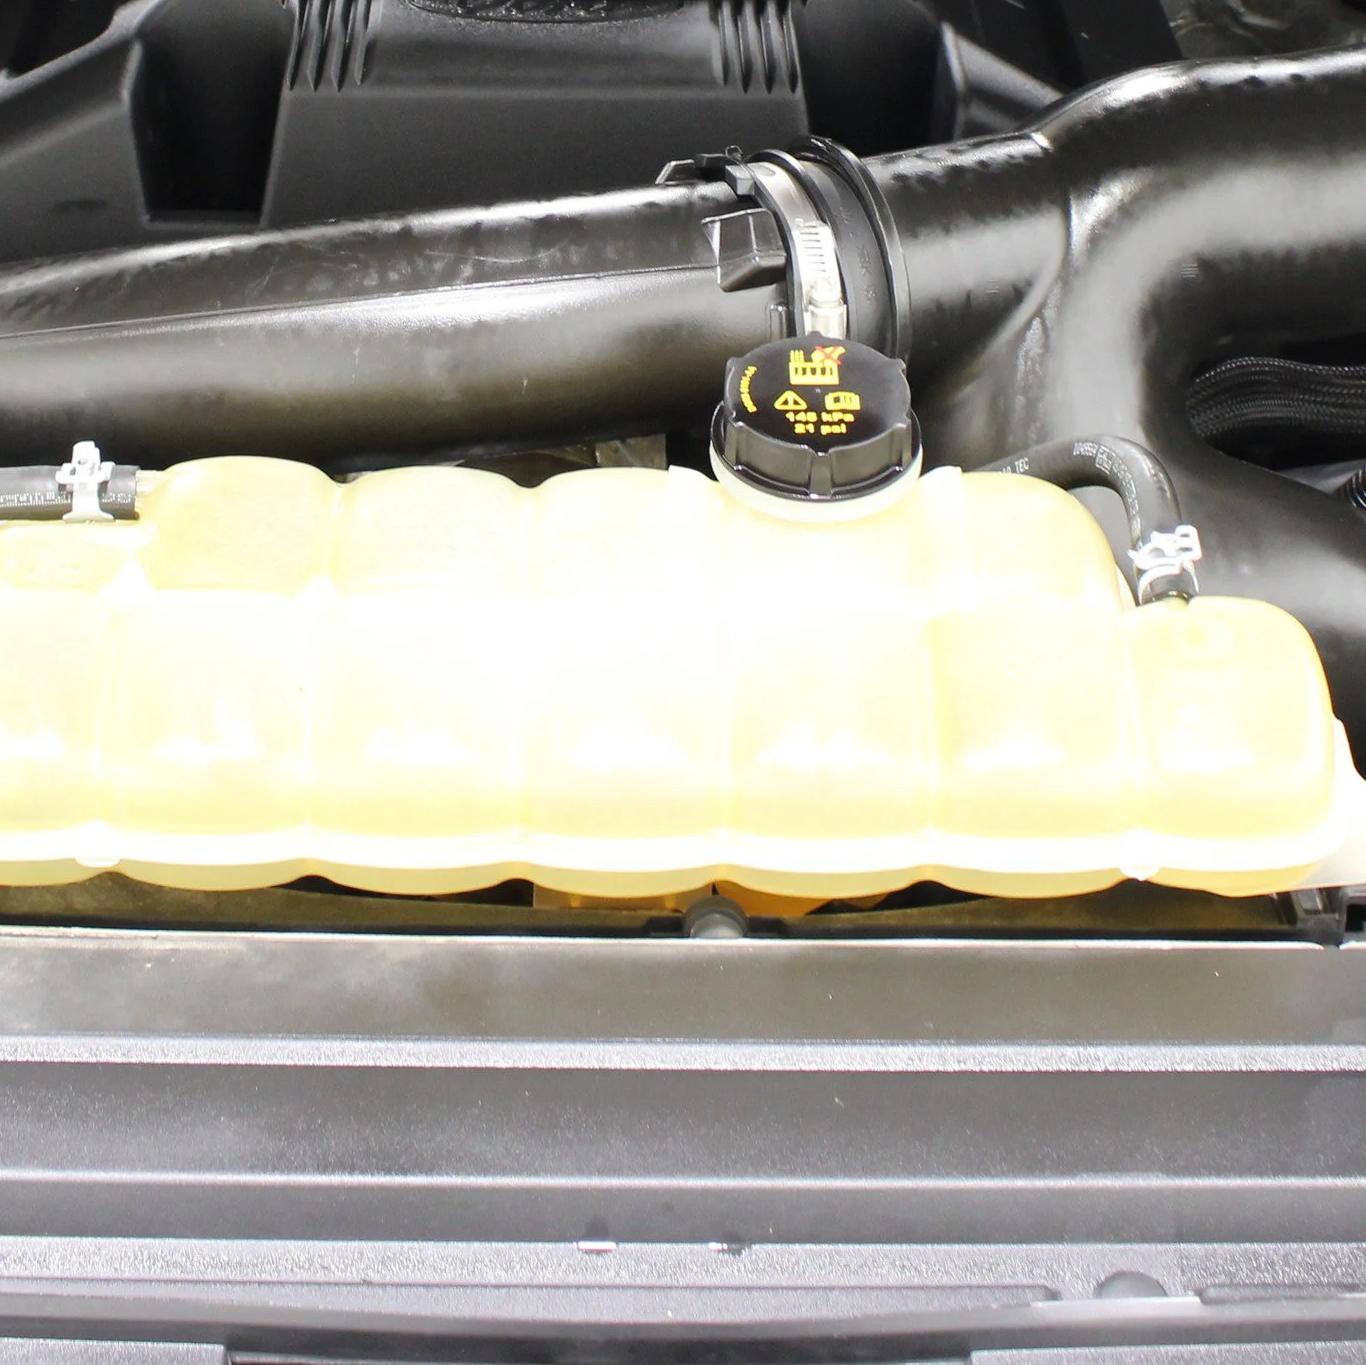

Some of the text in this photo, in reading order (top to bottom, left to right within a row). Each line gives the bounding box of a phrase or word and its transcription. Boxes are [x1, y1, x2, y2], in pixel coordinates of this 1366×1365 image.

[821, 411, 855, 423] kPa
[794, 422, 847, 435] 21 psi
